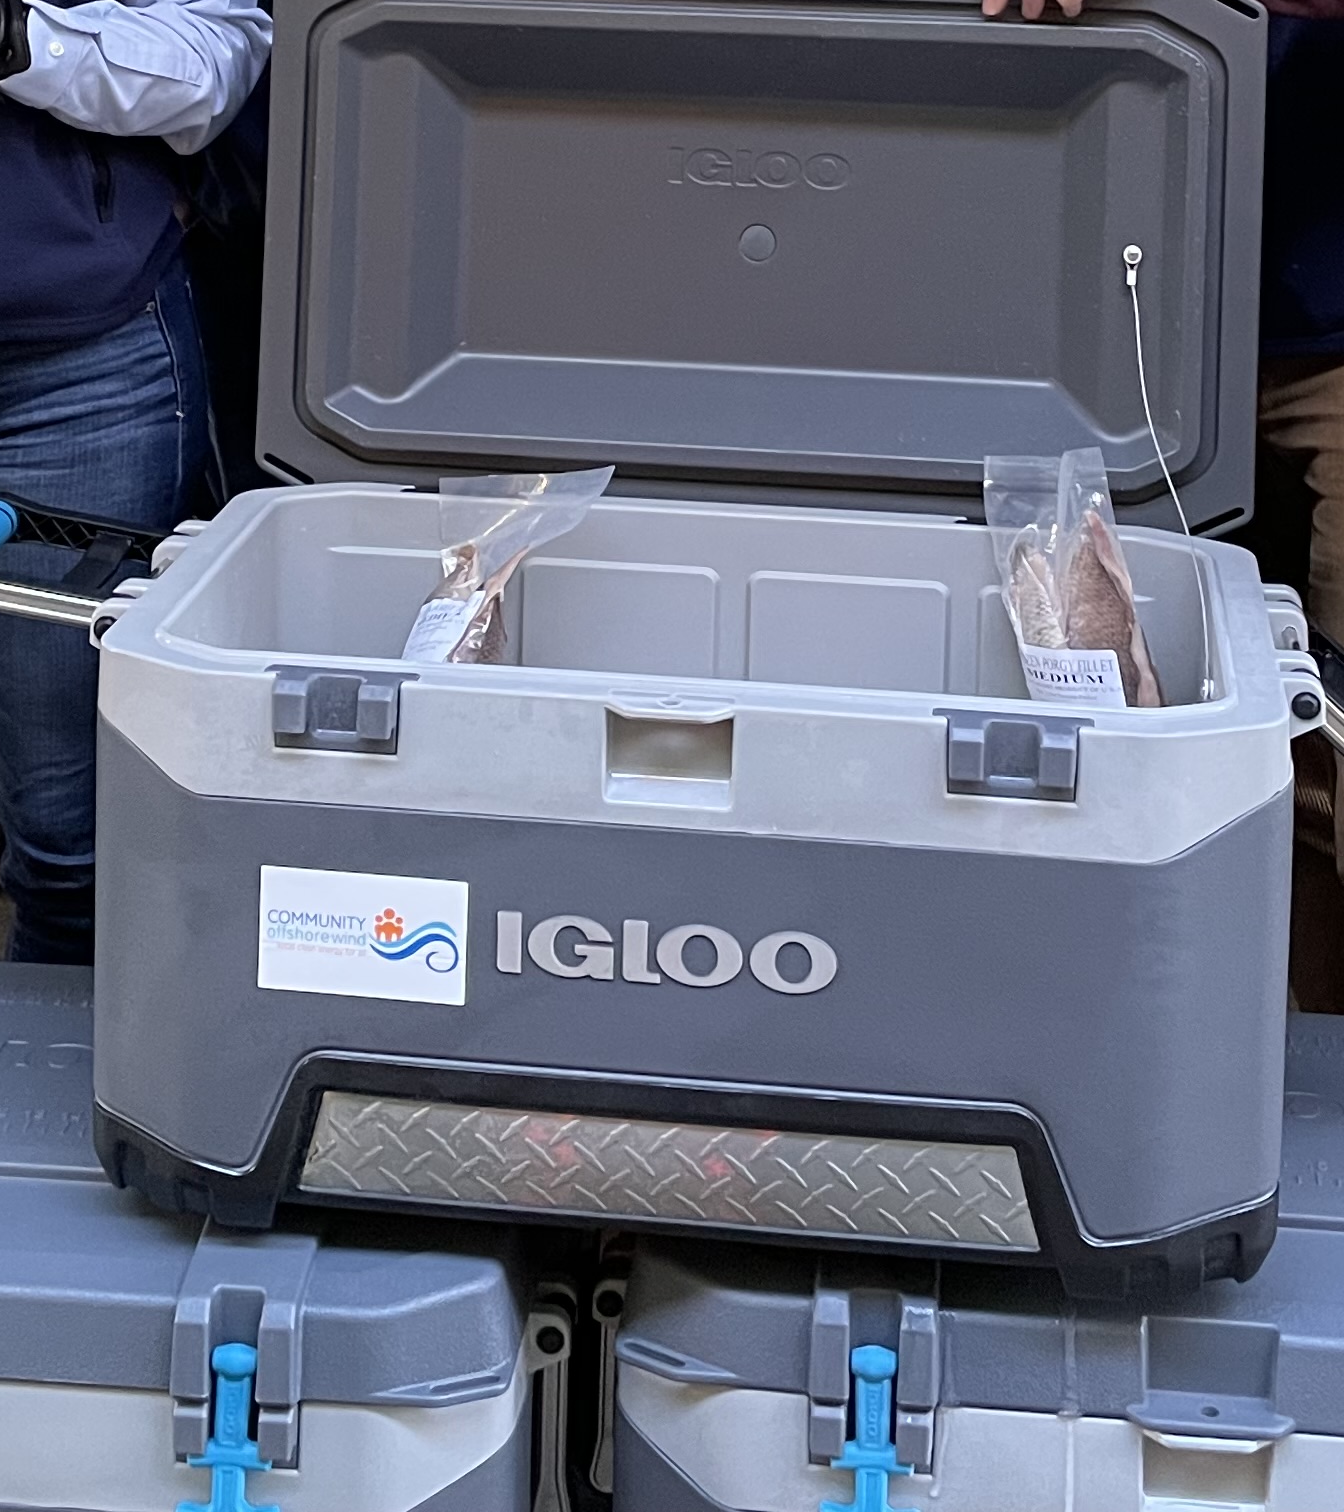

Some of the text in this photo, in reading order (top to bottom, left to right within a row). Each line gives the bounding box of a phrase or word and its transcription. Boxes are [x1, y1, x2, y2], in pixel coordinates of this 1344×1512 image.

[666, 146, 852, 191] IGLOO
[1026, 667, 1104, 684] MEDIUM
[1077, 659, 1114, 673] FILLET
[267, 908, 367, 931] COMMUNITY
[266, 924, 367, 947] offshore wind
[495, 909, 839, 995] IGLOO
